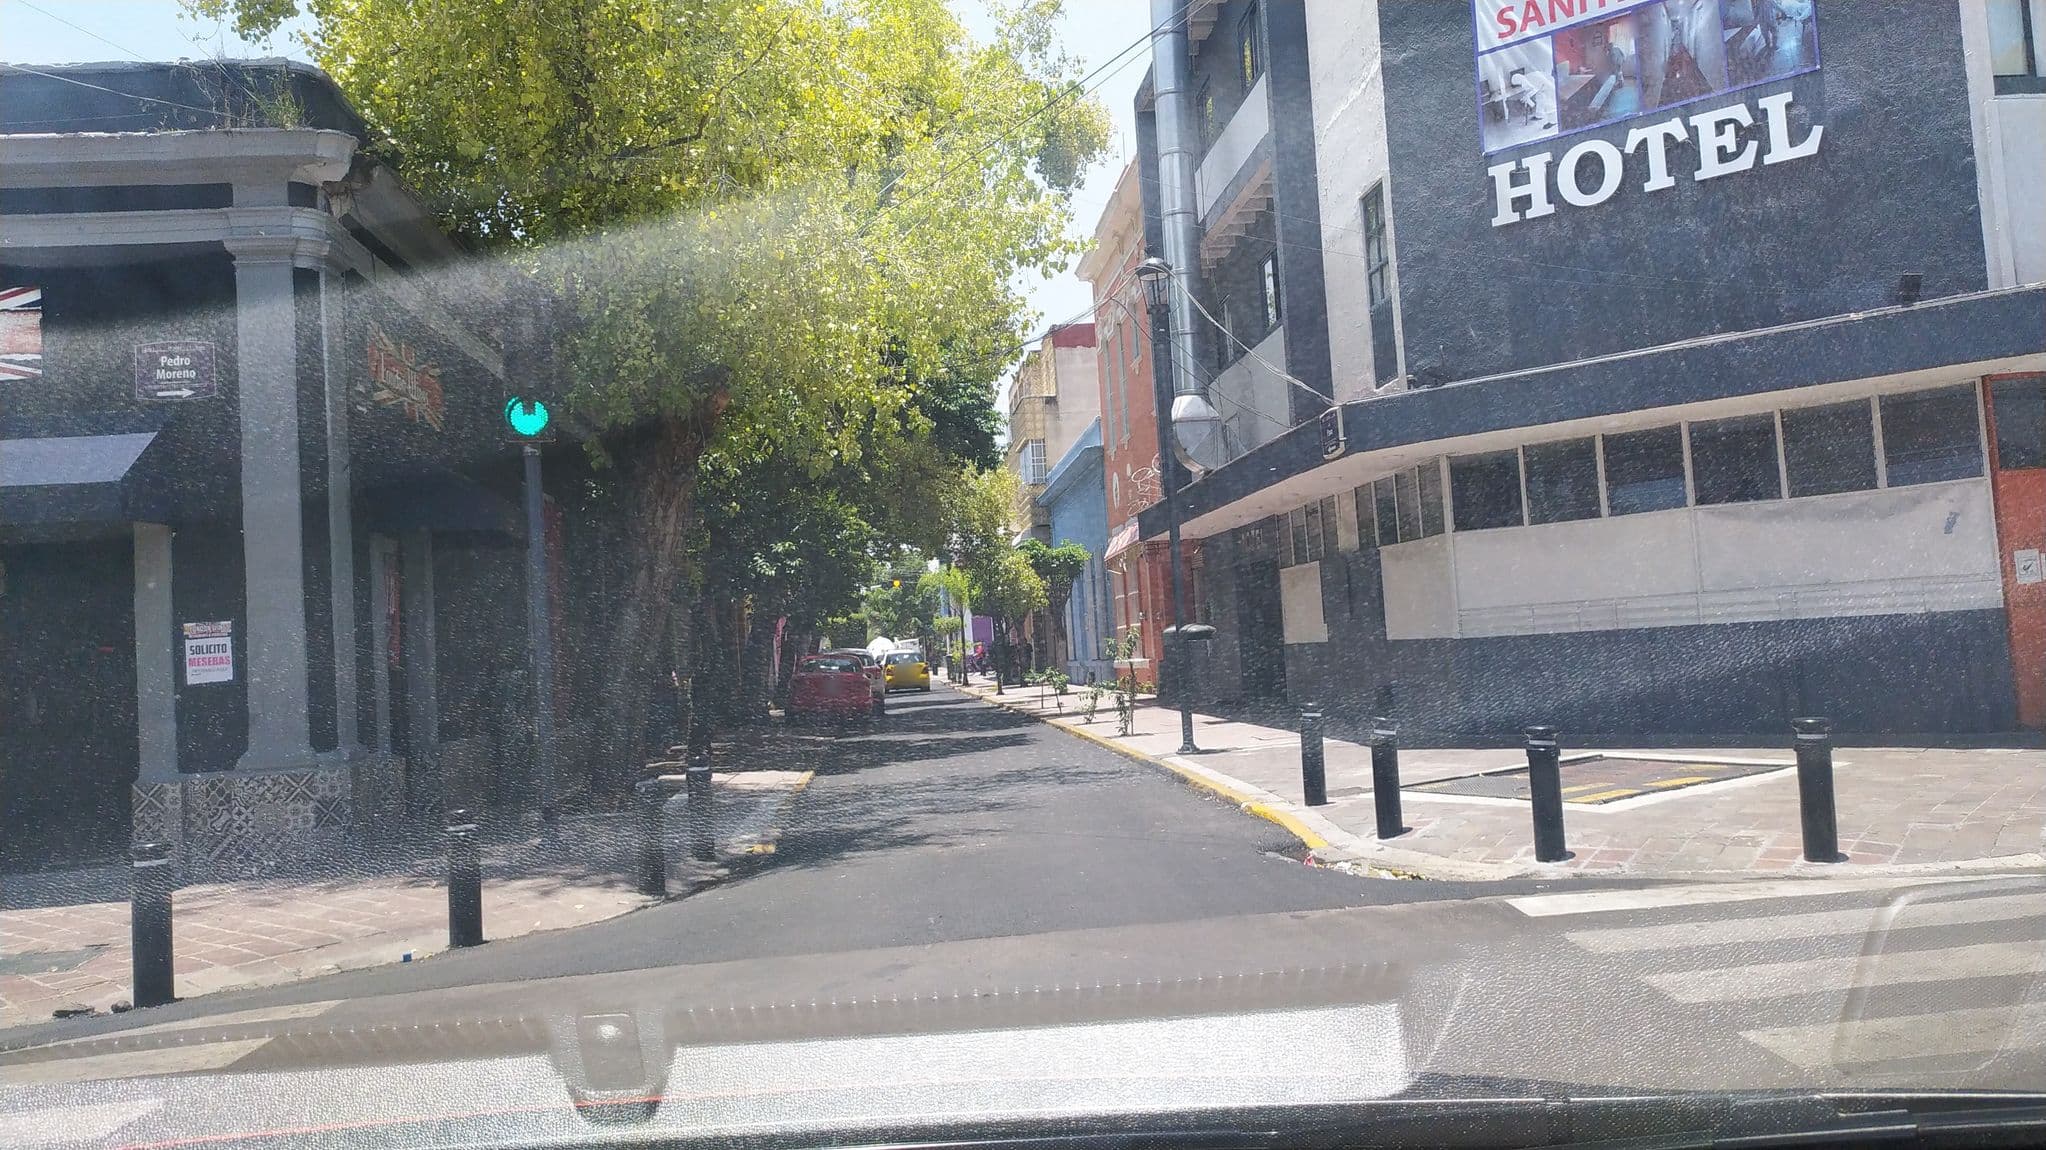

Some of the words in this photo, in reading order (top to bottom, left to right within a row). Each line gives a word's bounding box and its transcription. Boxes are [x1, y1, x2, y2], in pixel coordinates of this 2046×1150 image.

[1488, 91, 1824, 227] HOTEL
[160, 355, 191, 367] Pedro
[156, 369, 197, 380] Moreno
[190, 643, 227, 656] SOLICITO
